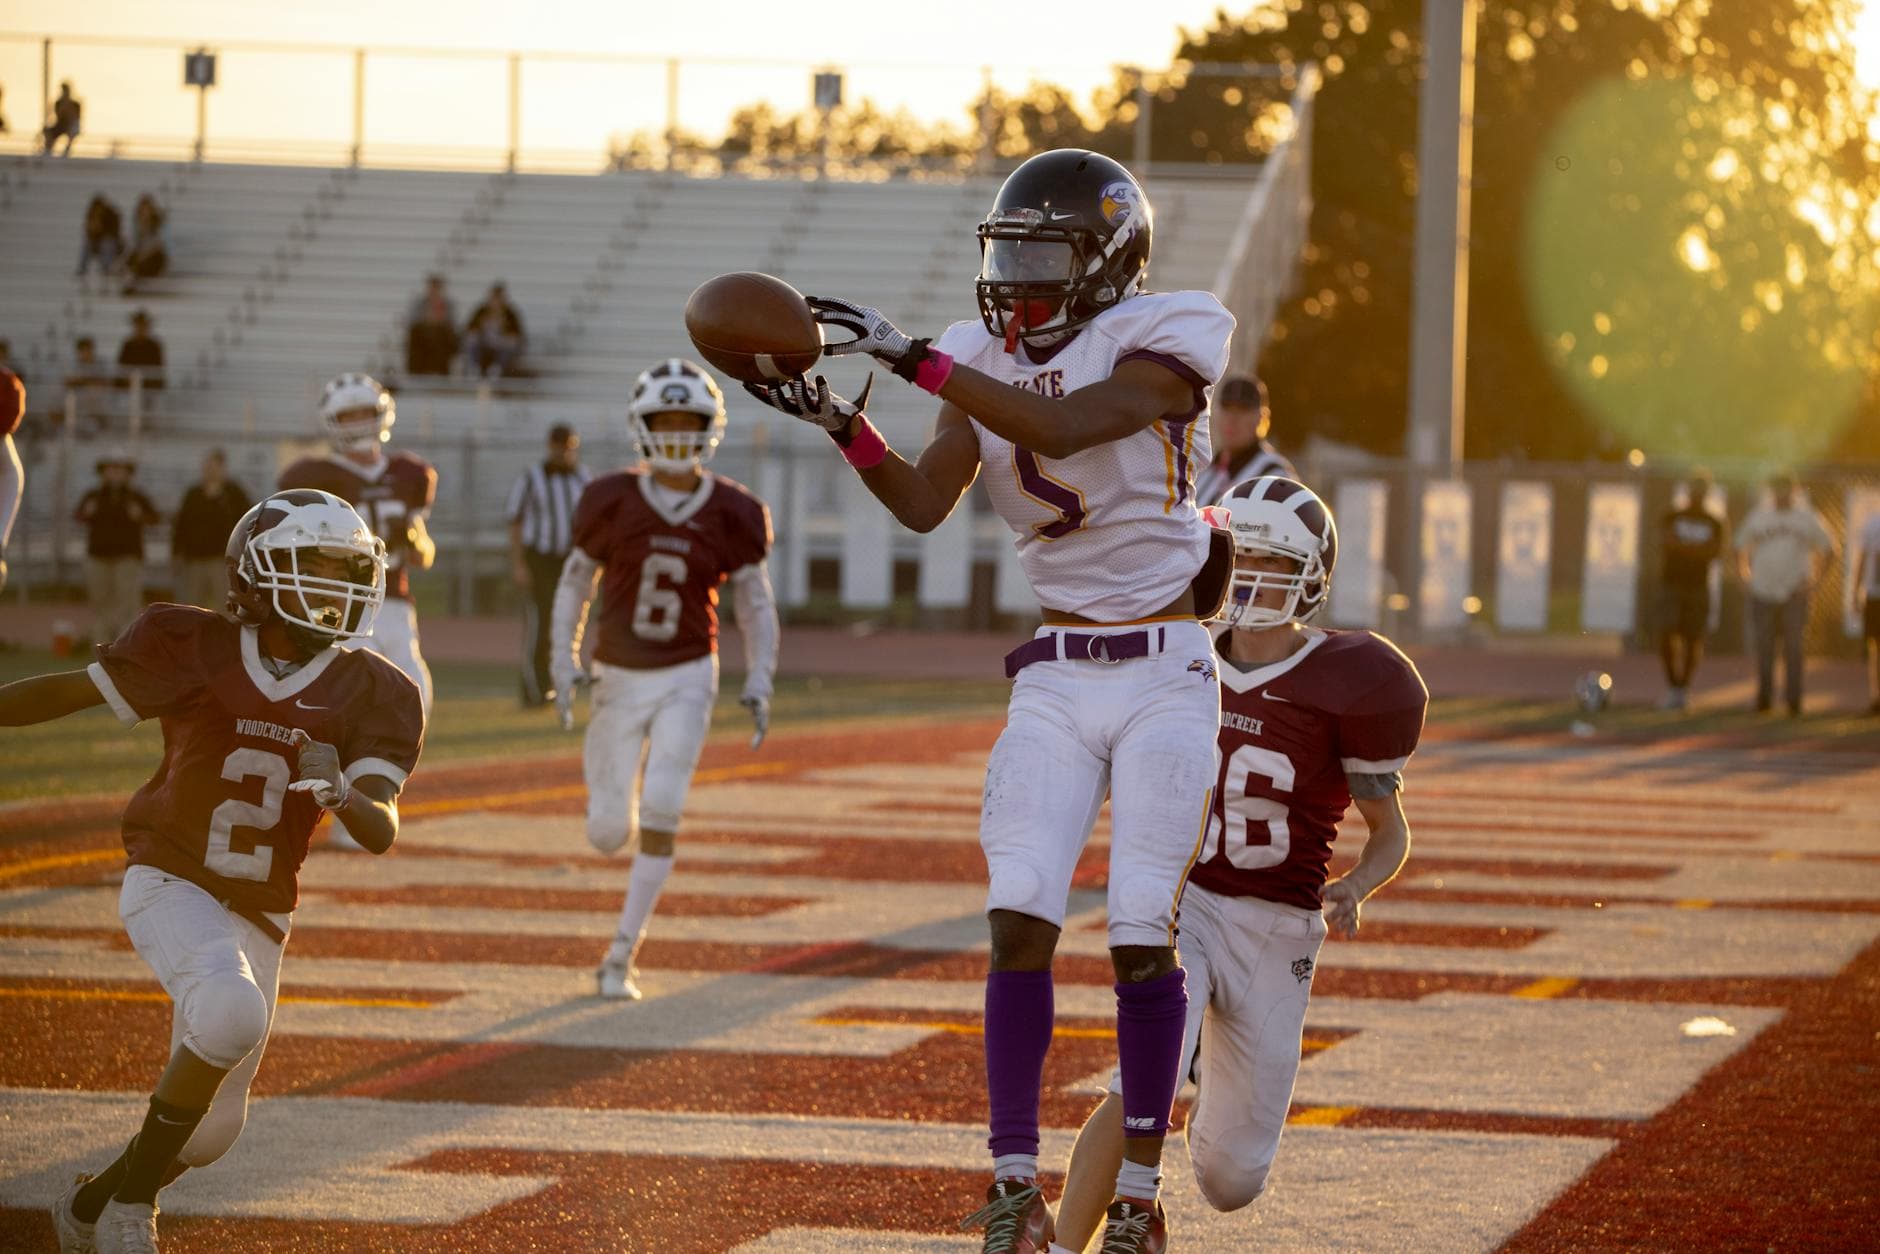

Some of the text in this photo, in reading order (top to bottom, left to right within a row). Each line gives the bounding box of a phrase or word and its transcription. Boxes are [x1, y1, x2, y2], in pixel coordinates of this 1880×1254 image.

[631, 553, 688, 641] 6
[1221, 711, 1264, 736] DCREEK
[204, 746, 291, 883] 2
[1200, 744, 1296, 869] 6
